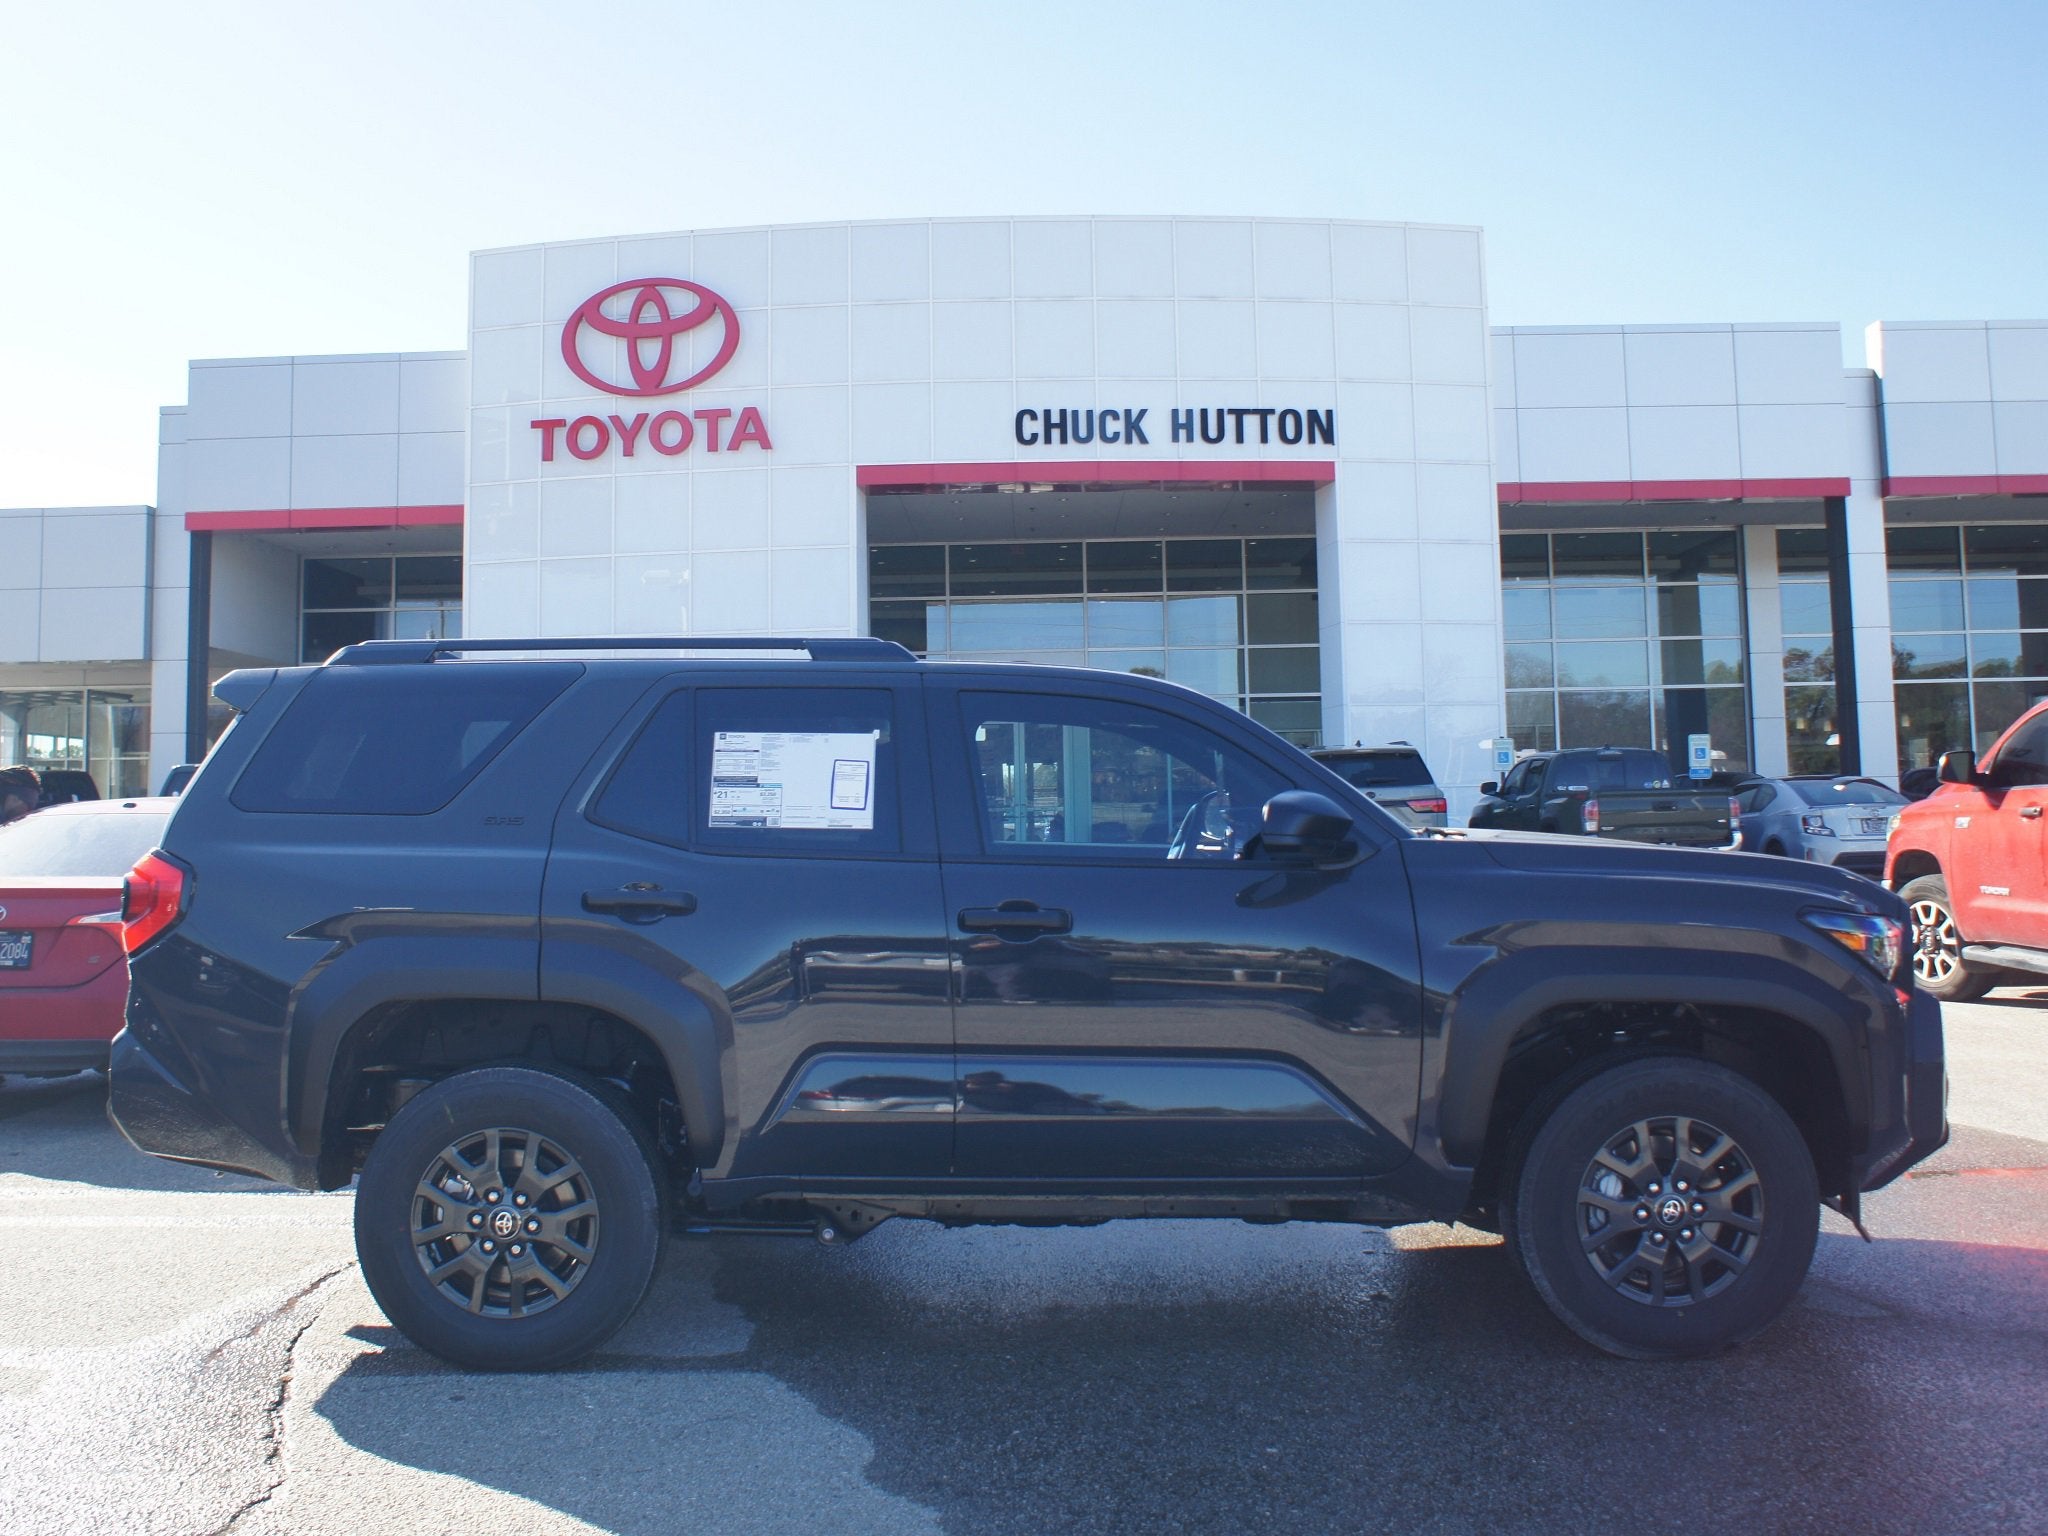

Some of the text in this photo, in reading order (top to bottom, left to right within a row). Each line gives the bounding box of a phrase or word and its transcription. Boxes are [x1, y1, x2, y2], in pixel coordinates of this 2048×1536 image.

[530, 406, 773, 462] TOYOTA
[1015, 408, 1335, 446] CHUCK HUTTON
[717, 790, 728, 799] 21
